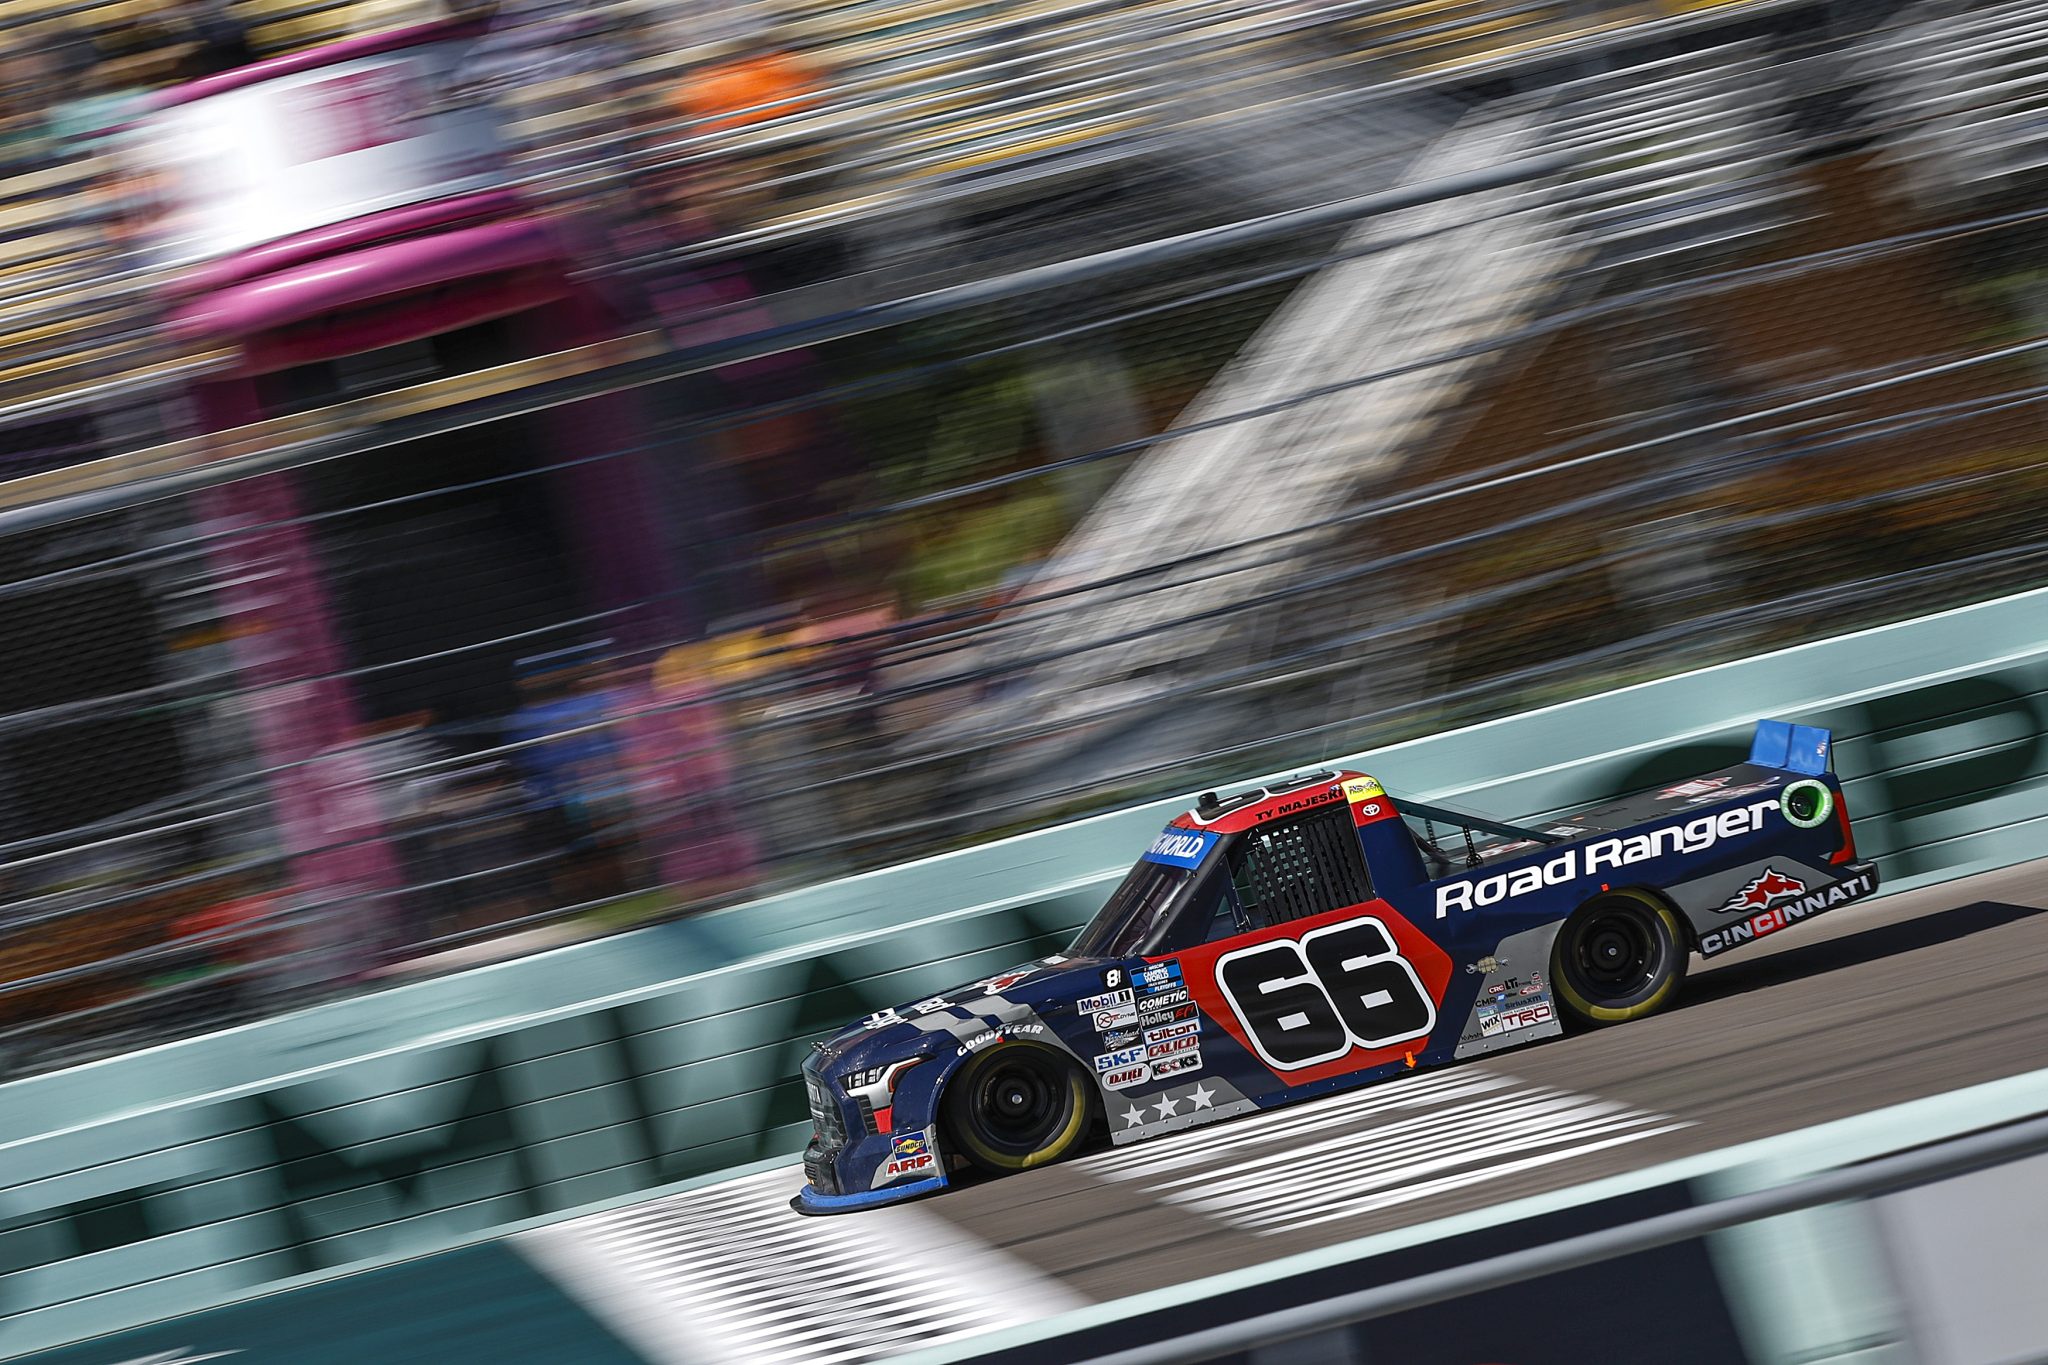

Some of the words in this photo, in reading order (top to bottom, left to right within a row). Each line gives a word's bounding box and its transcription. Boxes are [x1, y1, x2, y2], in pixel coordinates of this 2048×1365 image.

[1255, 809, 1274, 821] TY
[1278, 789, 1344, 815] MAJESKI
[1436, 850, 1576, 919] Road
[1585, 800, 1781, 875] Ranger
[1701, 875, 1872, 954] CINCINNATI
[1145, 973, 1169, 984] WORLD
[1488, 984, 1505, 994] CRC
[1081, 993, 1117, 1011] Mobil
[1140, 990, 1187, 1011] COMETIC
[1215, 914, 1437, 1072] 66
[1140, 1010, 1174, 1027] Holley
[1481, 1014, 1501, 1030] WIX
[1503, 1005, 1551, 1026] TRD
[957, 1024, 1044, 1057] GOODYEAR
[1148, 1023, 1198, 1041] tilton
[1148, 1036, 1198, 1057] CALICO
[1098, 1048, 1144, 1070] SKF
[896, 1141, 925, 1152] SUNOCO
[887, 1154, 933, 1174] ARP
